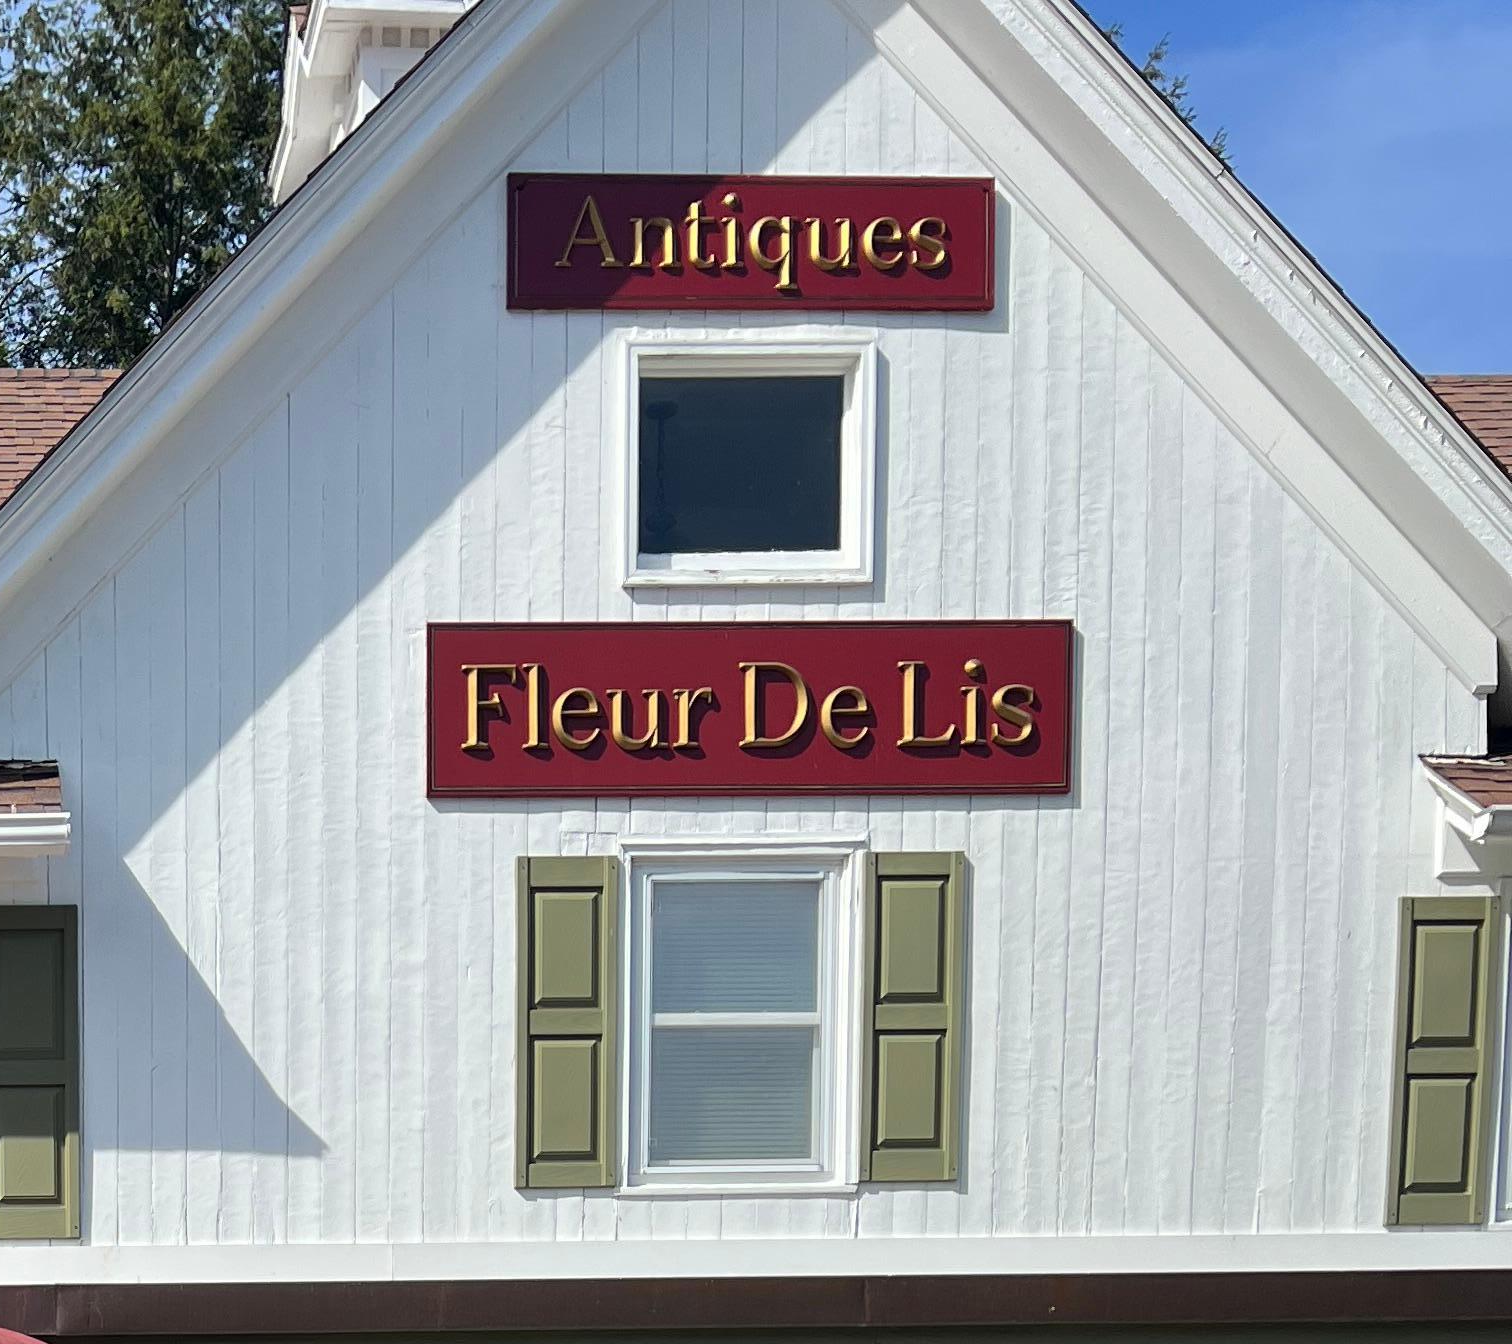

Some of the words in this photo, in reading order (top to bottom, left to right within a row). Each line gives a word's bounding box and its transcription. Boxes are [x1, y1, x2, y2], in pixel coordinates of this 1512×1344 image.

[554, 192, 947, 290] Antiques
[460, 662, 713, 750] Fleur
[738, 661, 870, 749] De
[896, 658, 1035, 748] Lis
